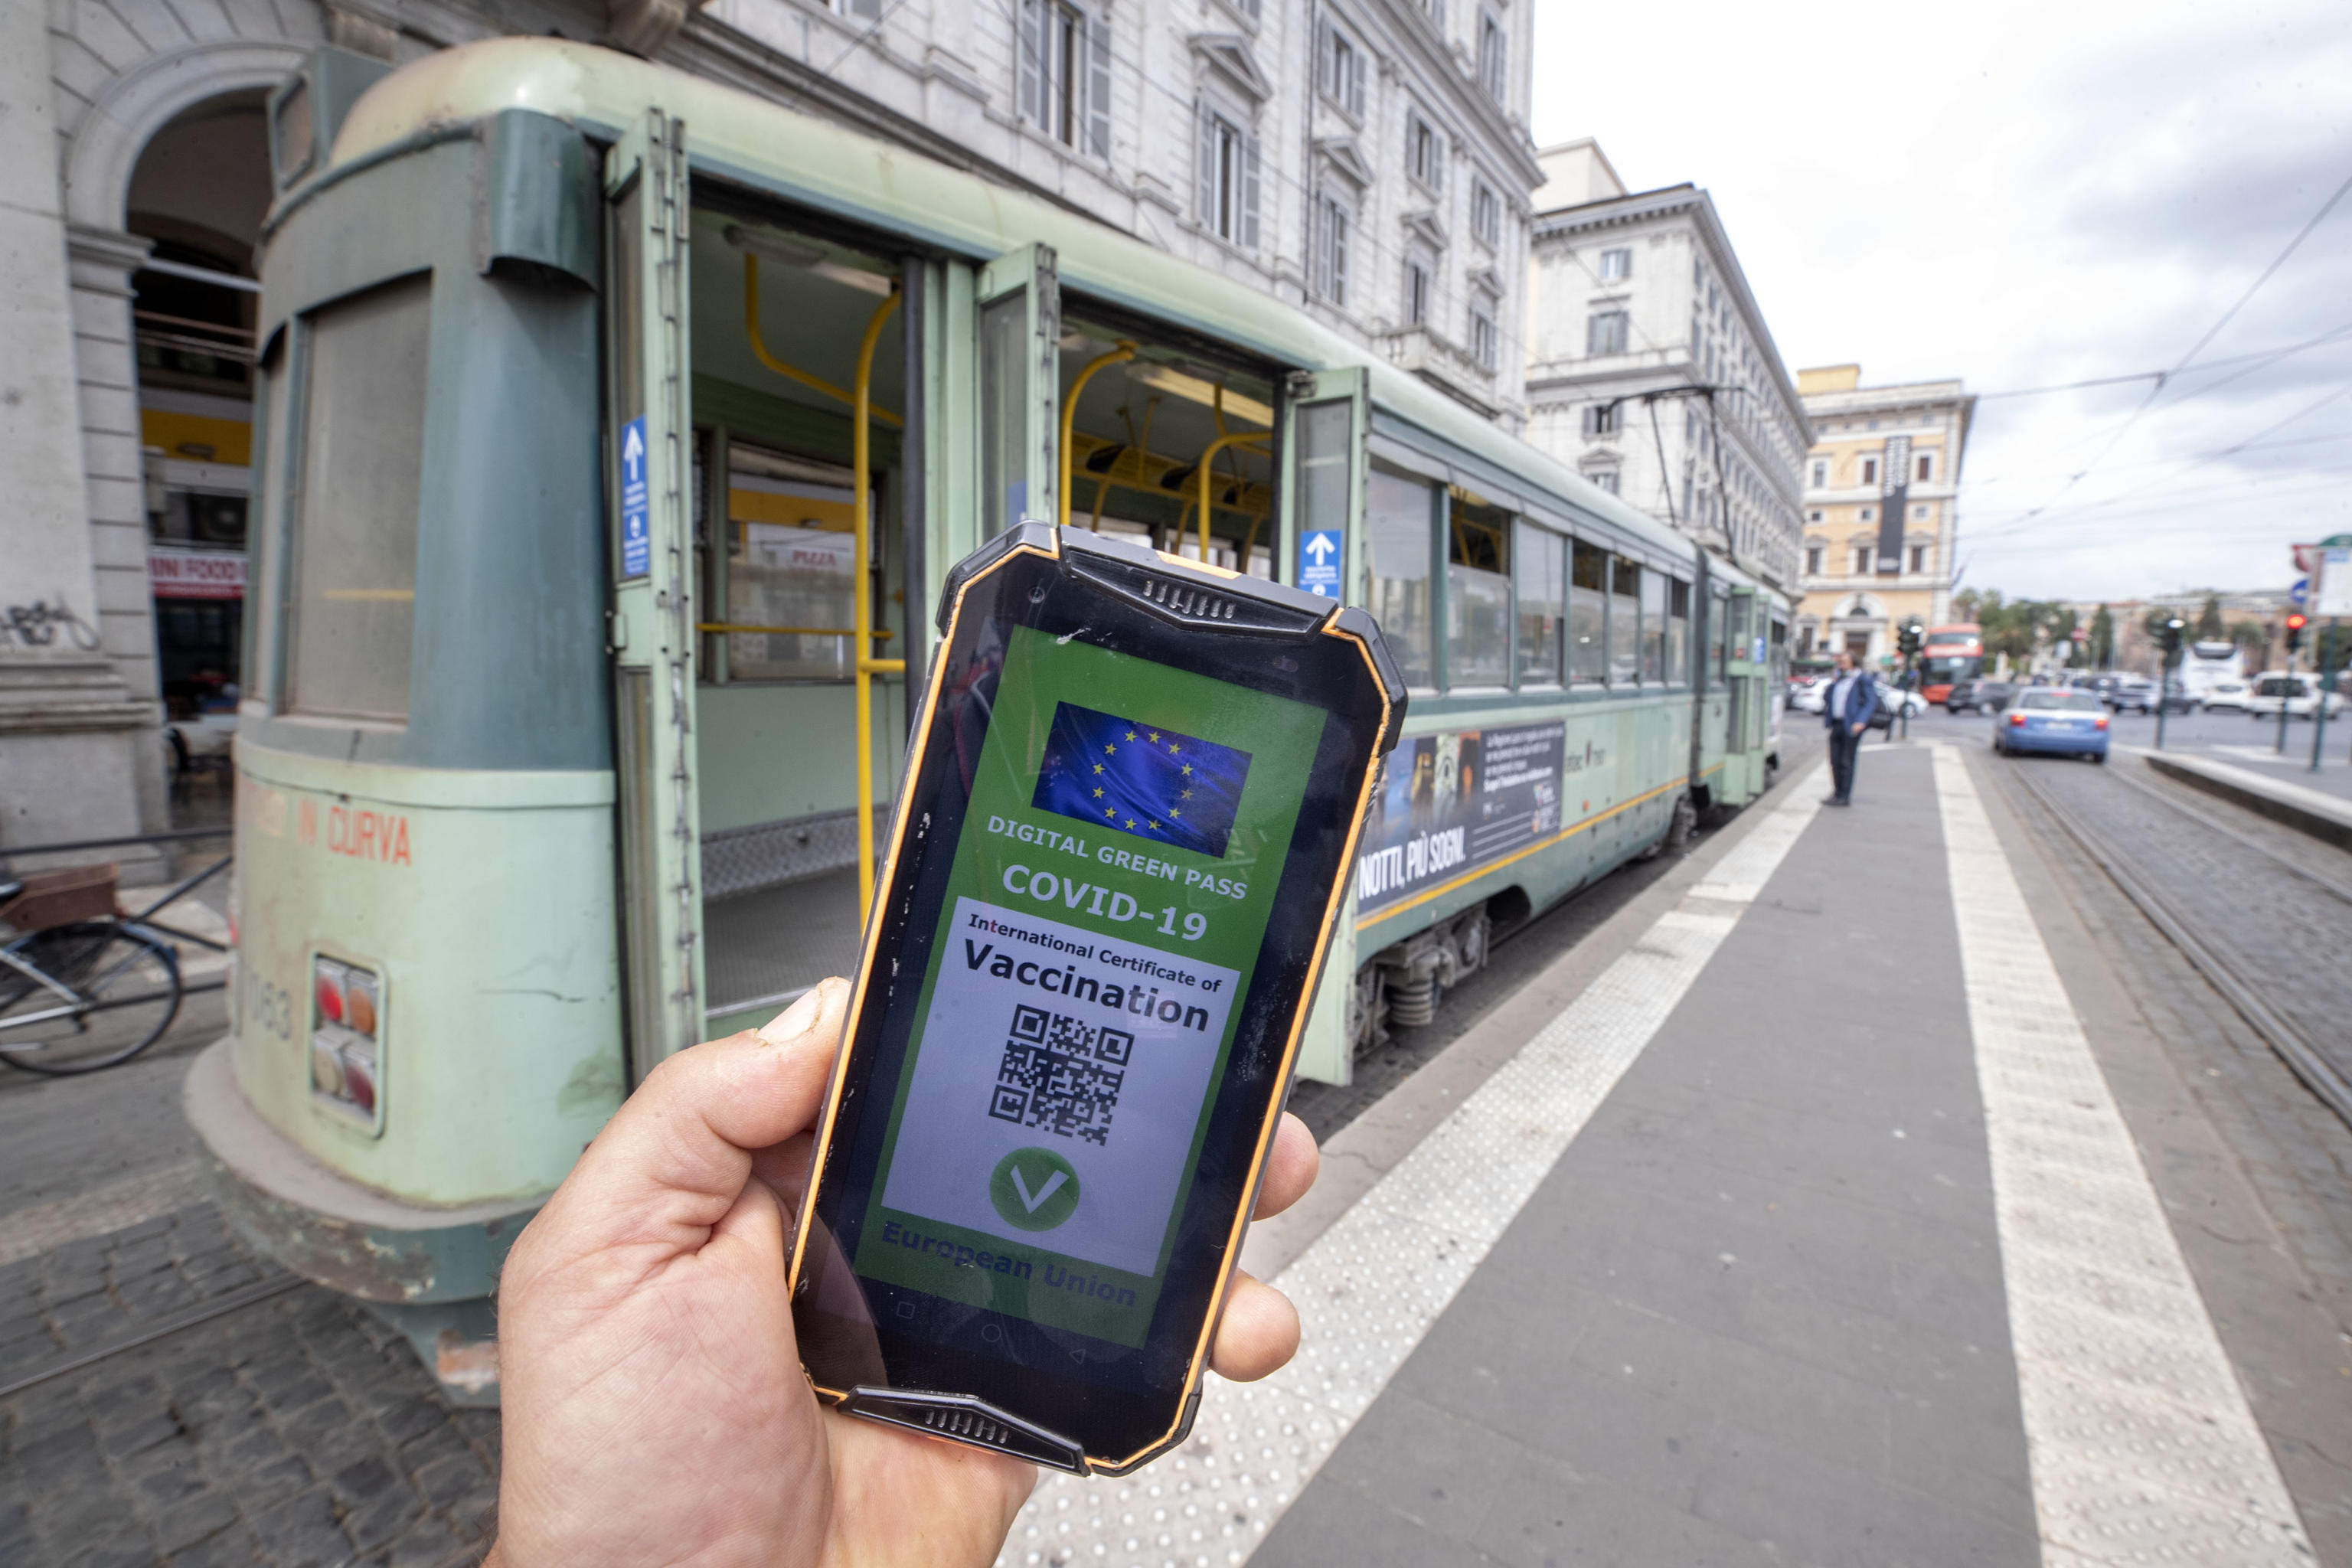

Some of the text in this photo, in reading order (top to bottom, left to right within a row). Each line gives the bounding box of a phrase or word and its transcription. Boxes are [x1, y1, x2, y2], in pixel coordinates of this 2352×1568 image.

[327, 805, 412, 867] CURVA
[987, 815, 1248, 900] DIGITAL GREEN PASS
[1358, 844, 1406, 900] NOTTI,
[1406, 829, 1429, 882] PIÙ
[1002, 864, 1207, 942] COVID-19
[965, 938, 1210, 1032] Vaccination
[968, 913, 1223, 993] International Certificate of
[882, 1220, 1136, 1307] European Union
